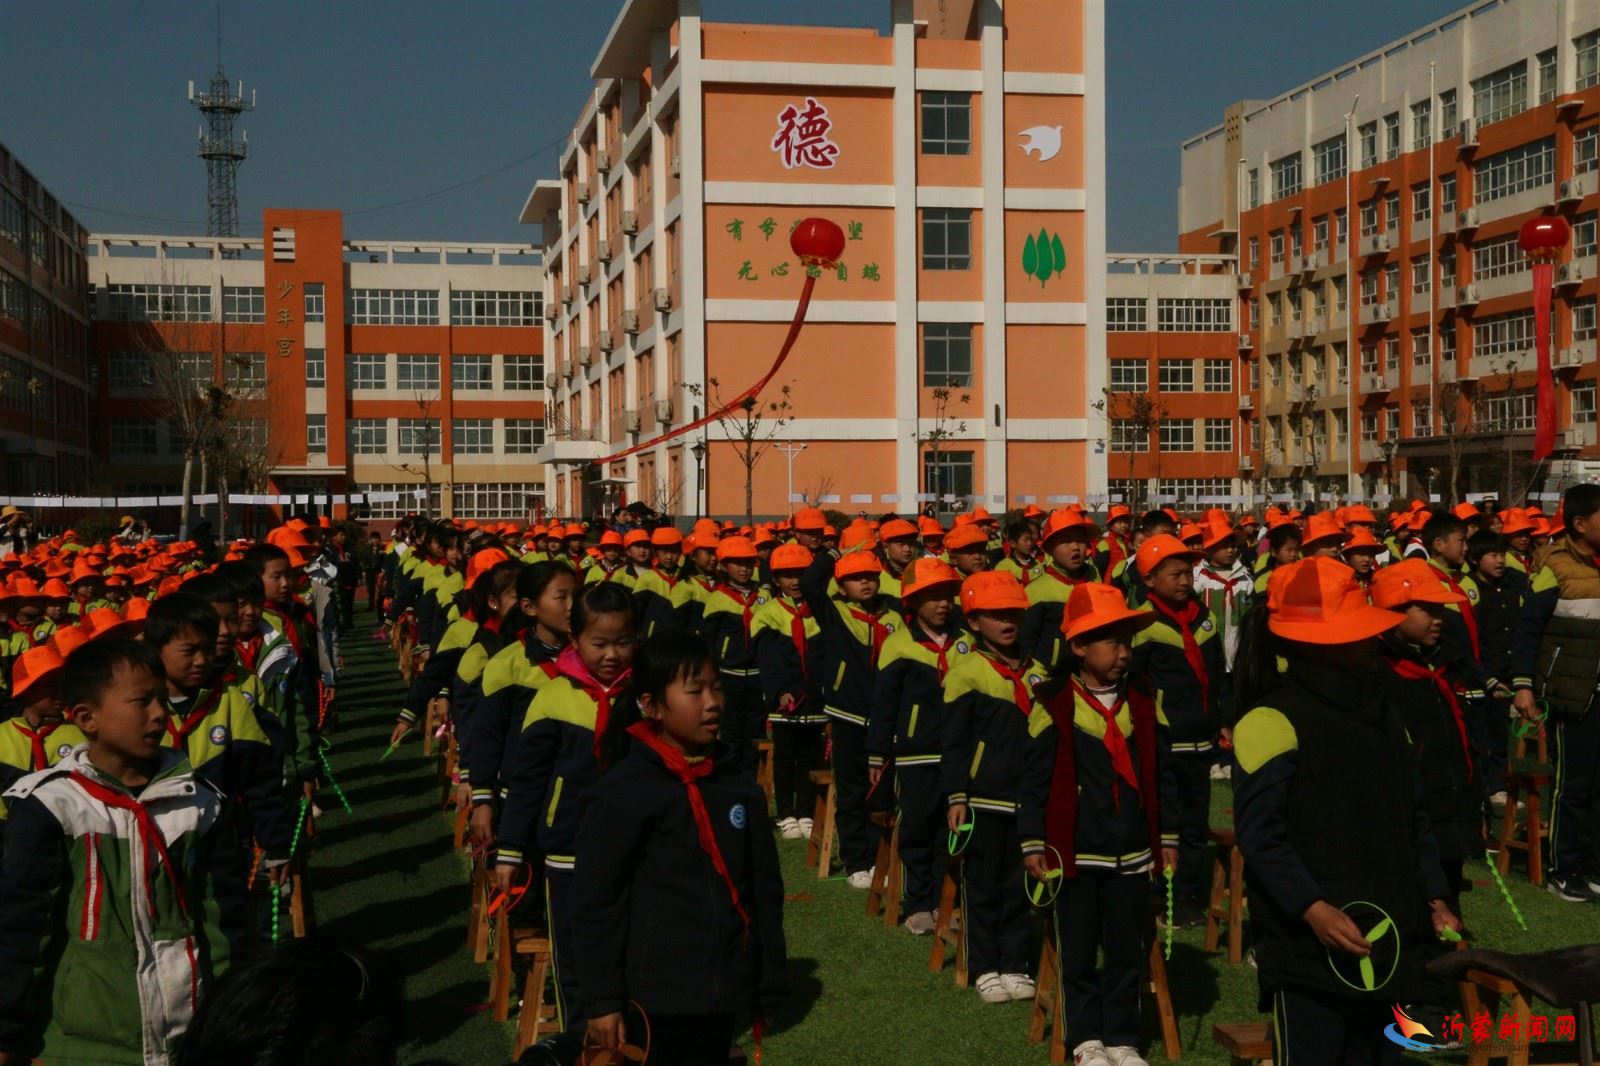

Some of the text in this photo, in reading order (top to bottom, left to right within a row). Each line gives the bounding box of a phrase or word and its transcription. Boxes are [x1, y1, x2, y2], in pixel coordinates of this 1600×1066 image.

[772, 97, 840, 169] 德
[726, 217, 864, 242] 有节坚
[276, 279, 296, 358] 少年宫
